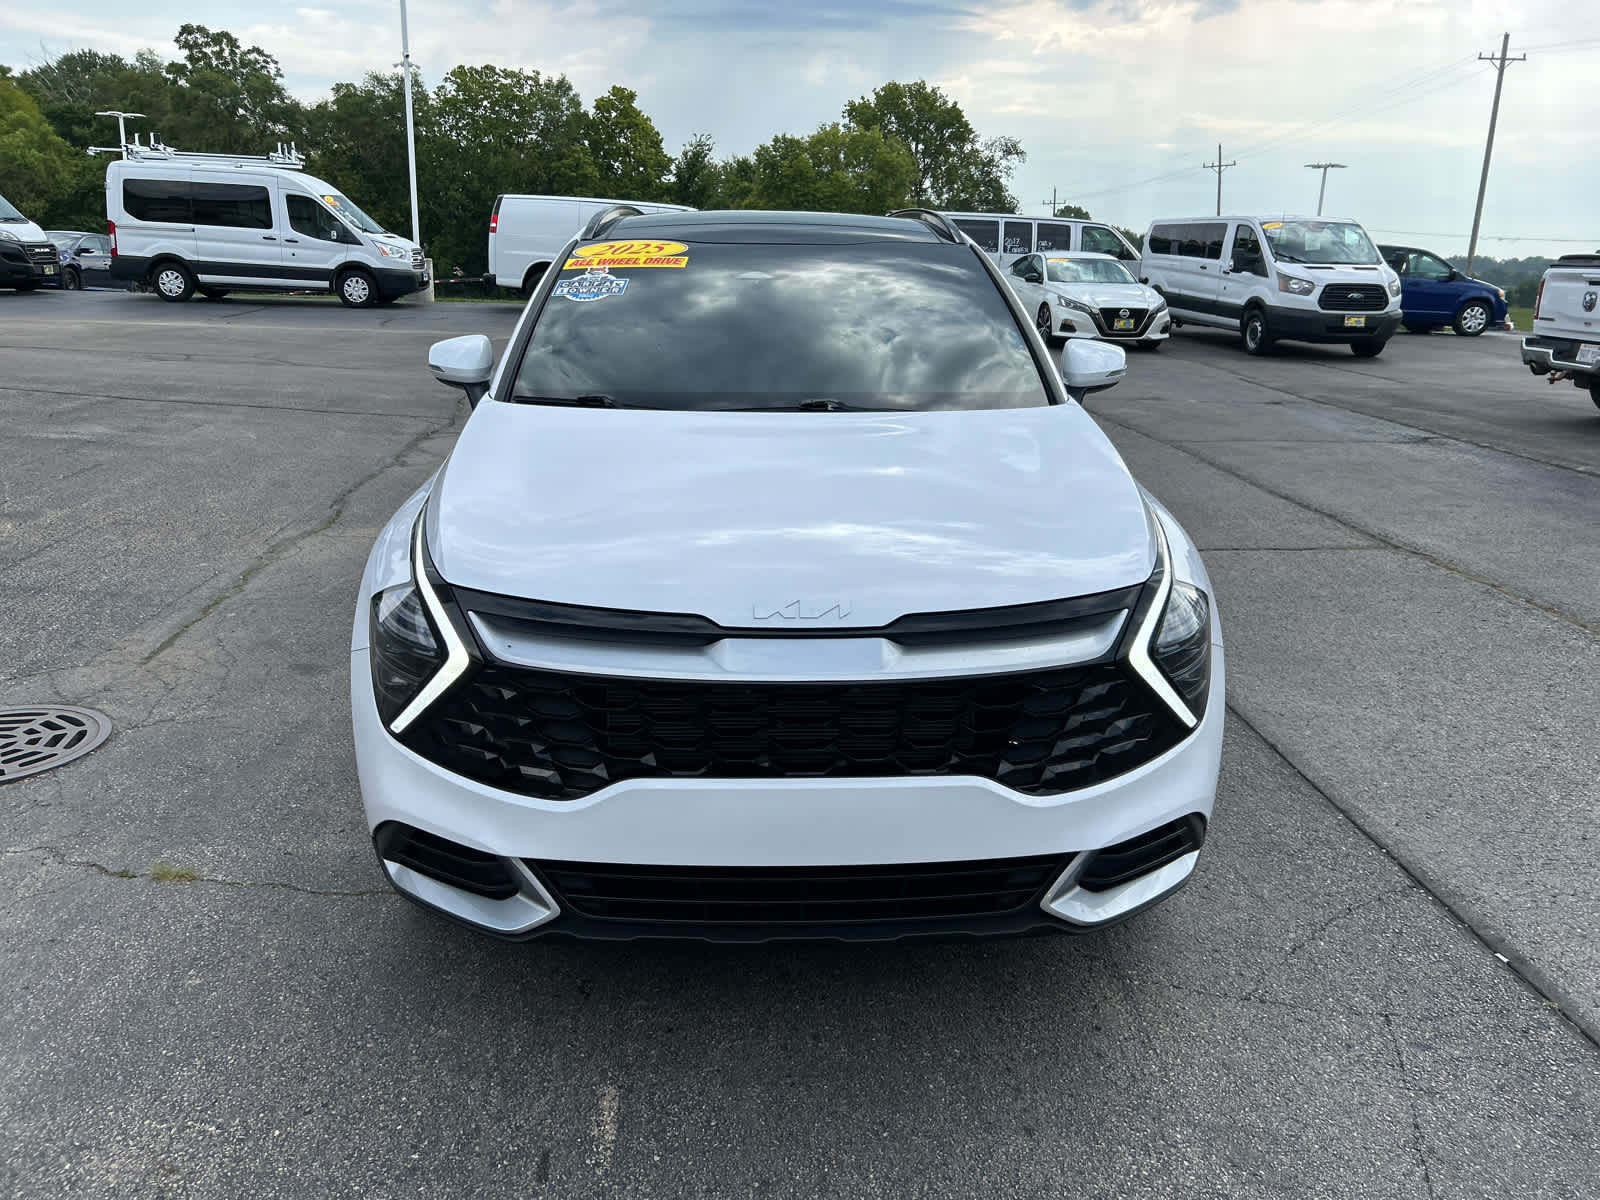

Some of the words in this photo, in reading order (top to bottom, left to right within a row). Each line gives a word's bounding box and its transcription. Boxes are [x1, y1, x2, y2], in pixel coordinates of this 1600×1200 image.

[592, 243, 672, 256] 2025
[569, 259, 594, 268] ALL
[598, 257, 640, 266] WHEEL
[642, 257, 684, 265] DRIVE
[752, 600, 851, 620] KIA
